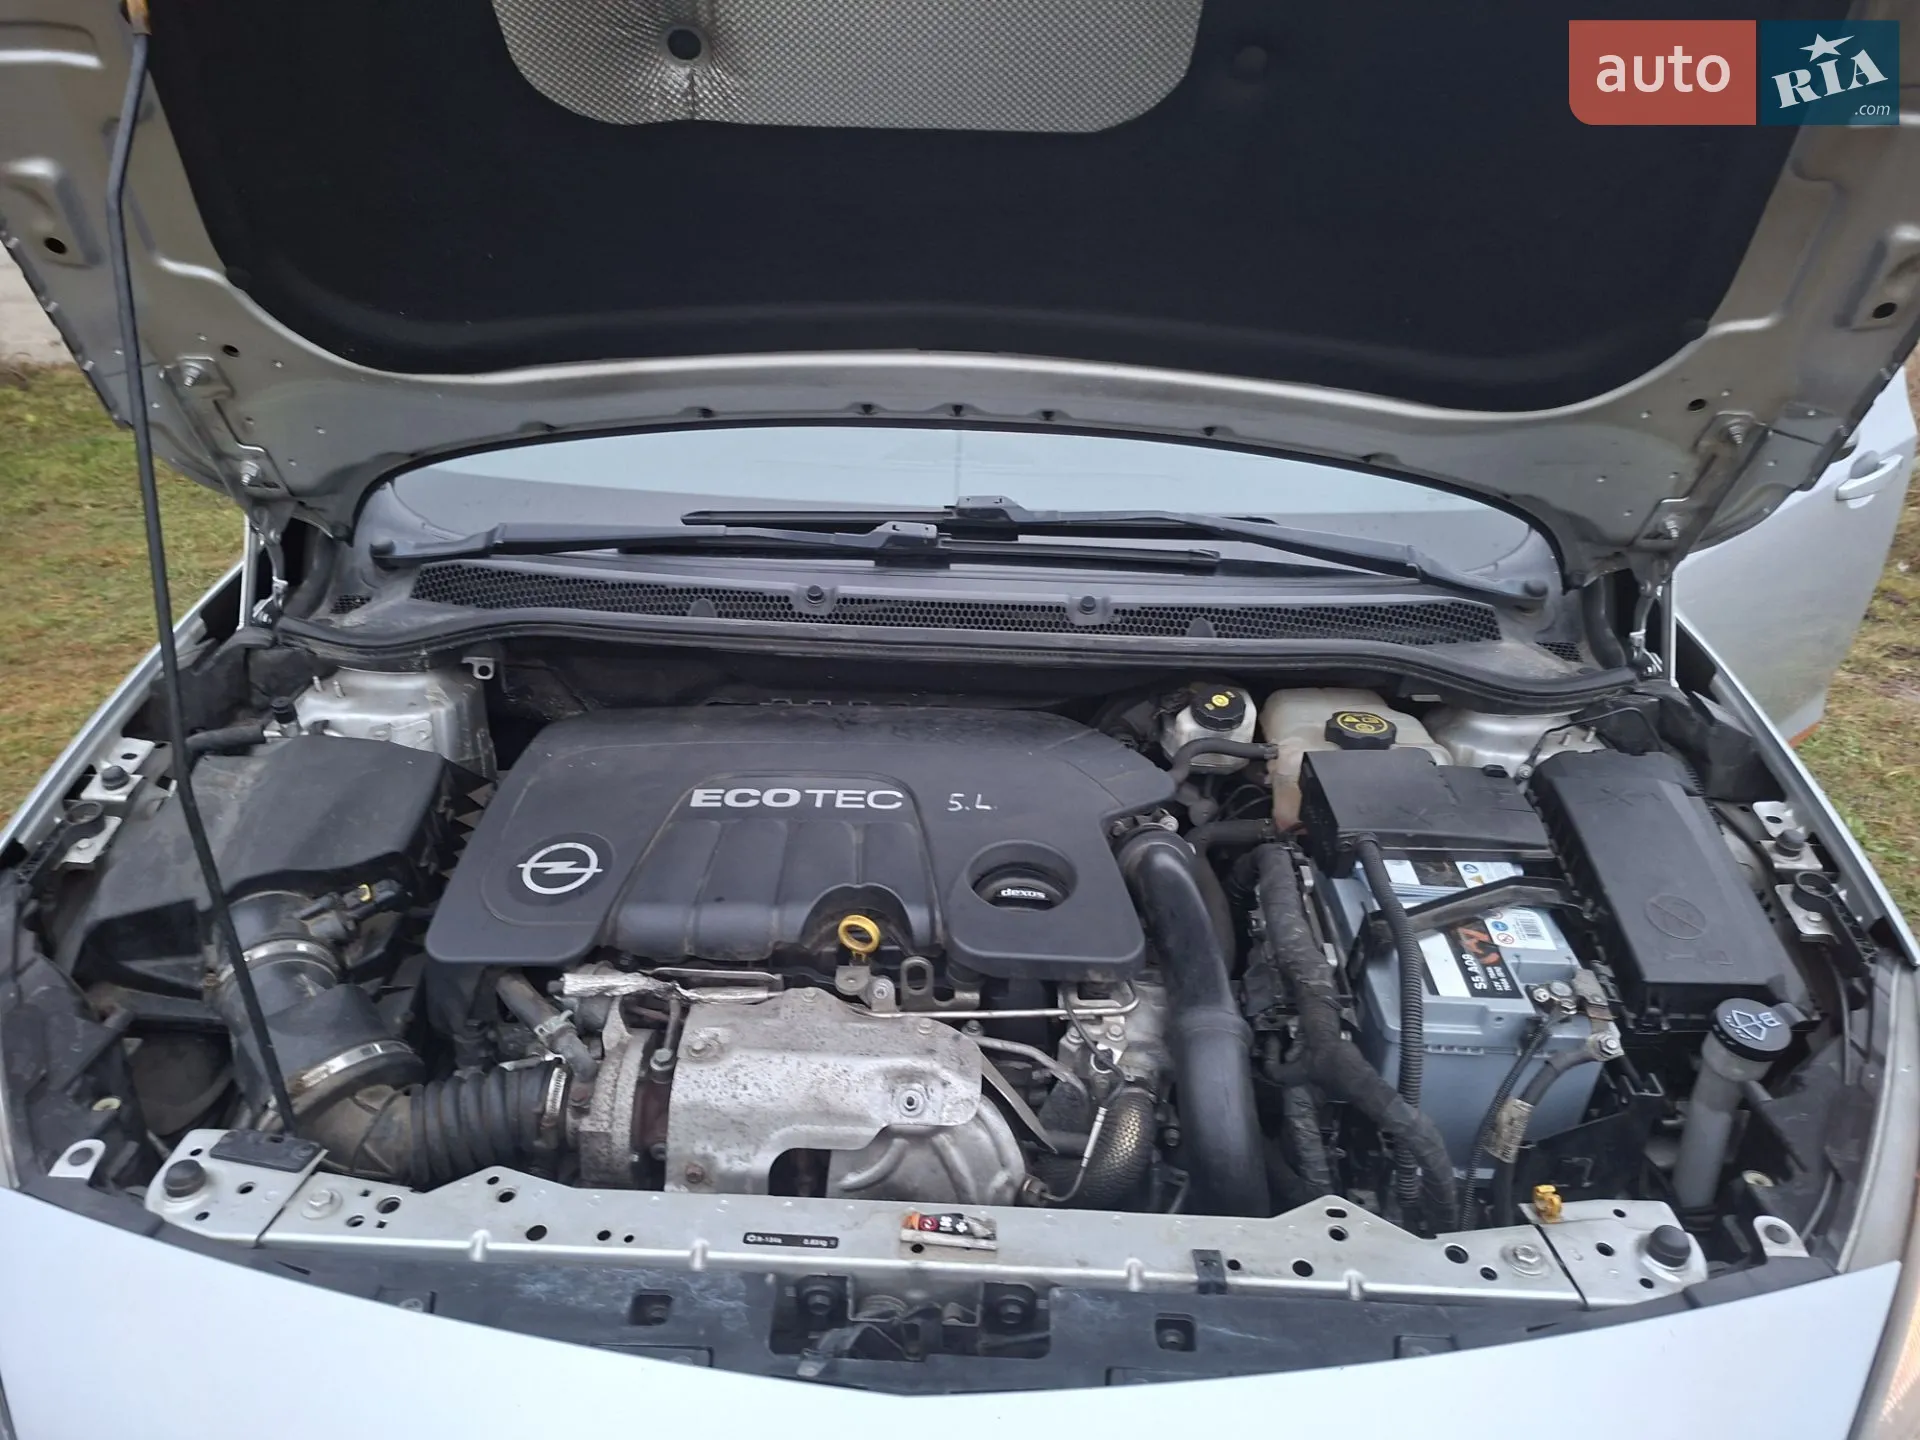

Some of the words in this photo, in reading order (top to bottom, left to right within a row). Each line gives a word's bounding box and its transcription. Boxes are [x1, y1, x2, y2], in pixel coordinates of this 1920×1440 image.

[689, 787, 904, 810] ECOTEC
[1000, 887, 1047, 899] dexos
[1470, 975, 1488, 990] S5
